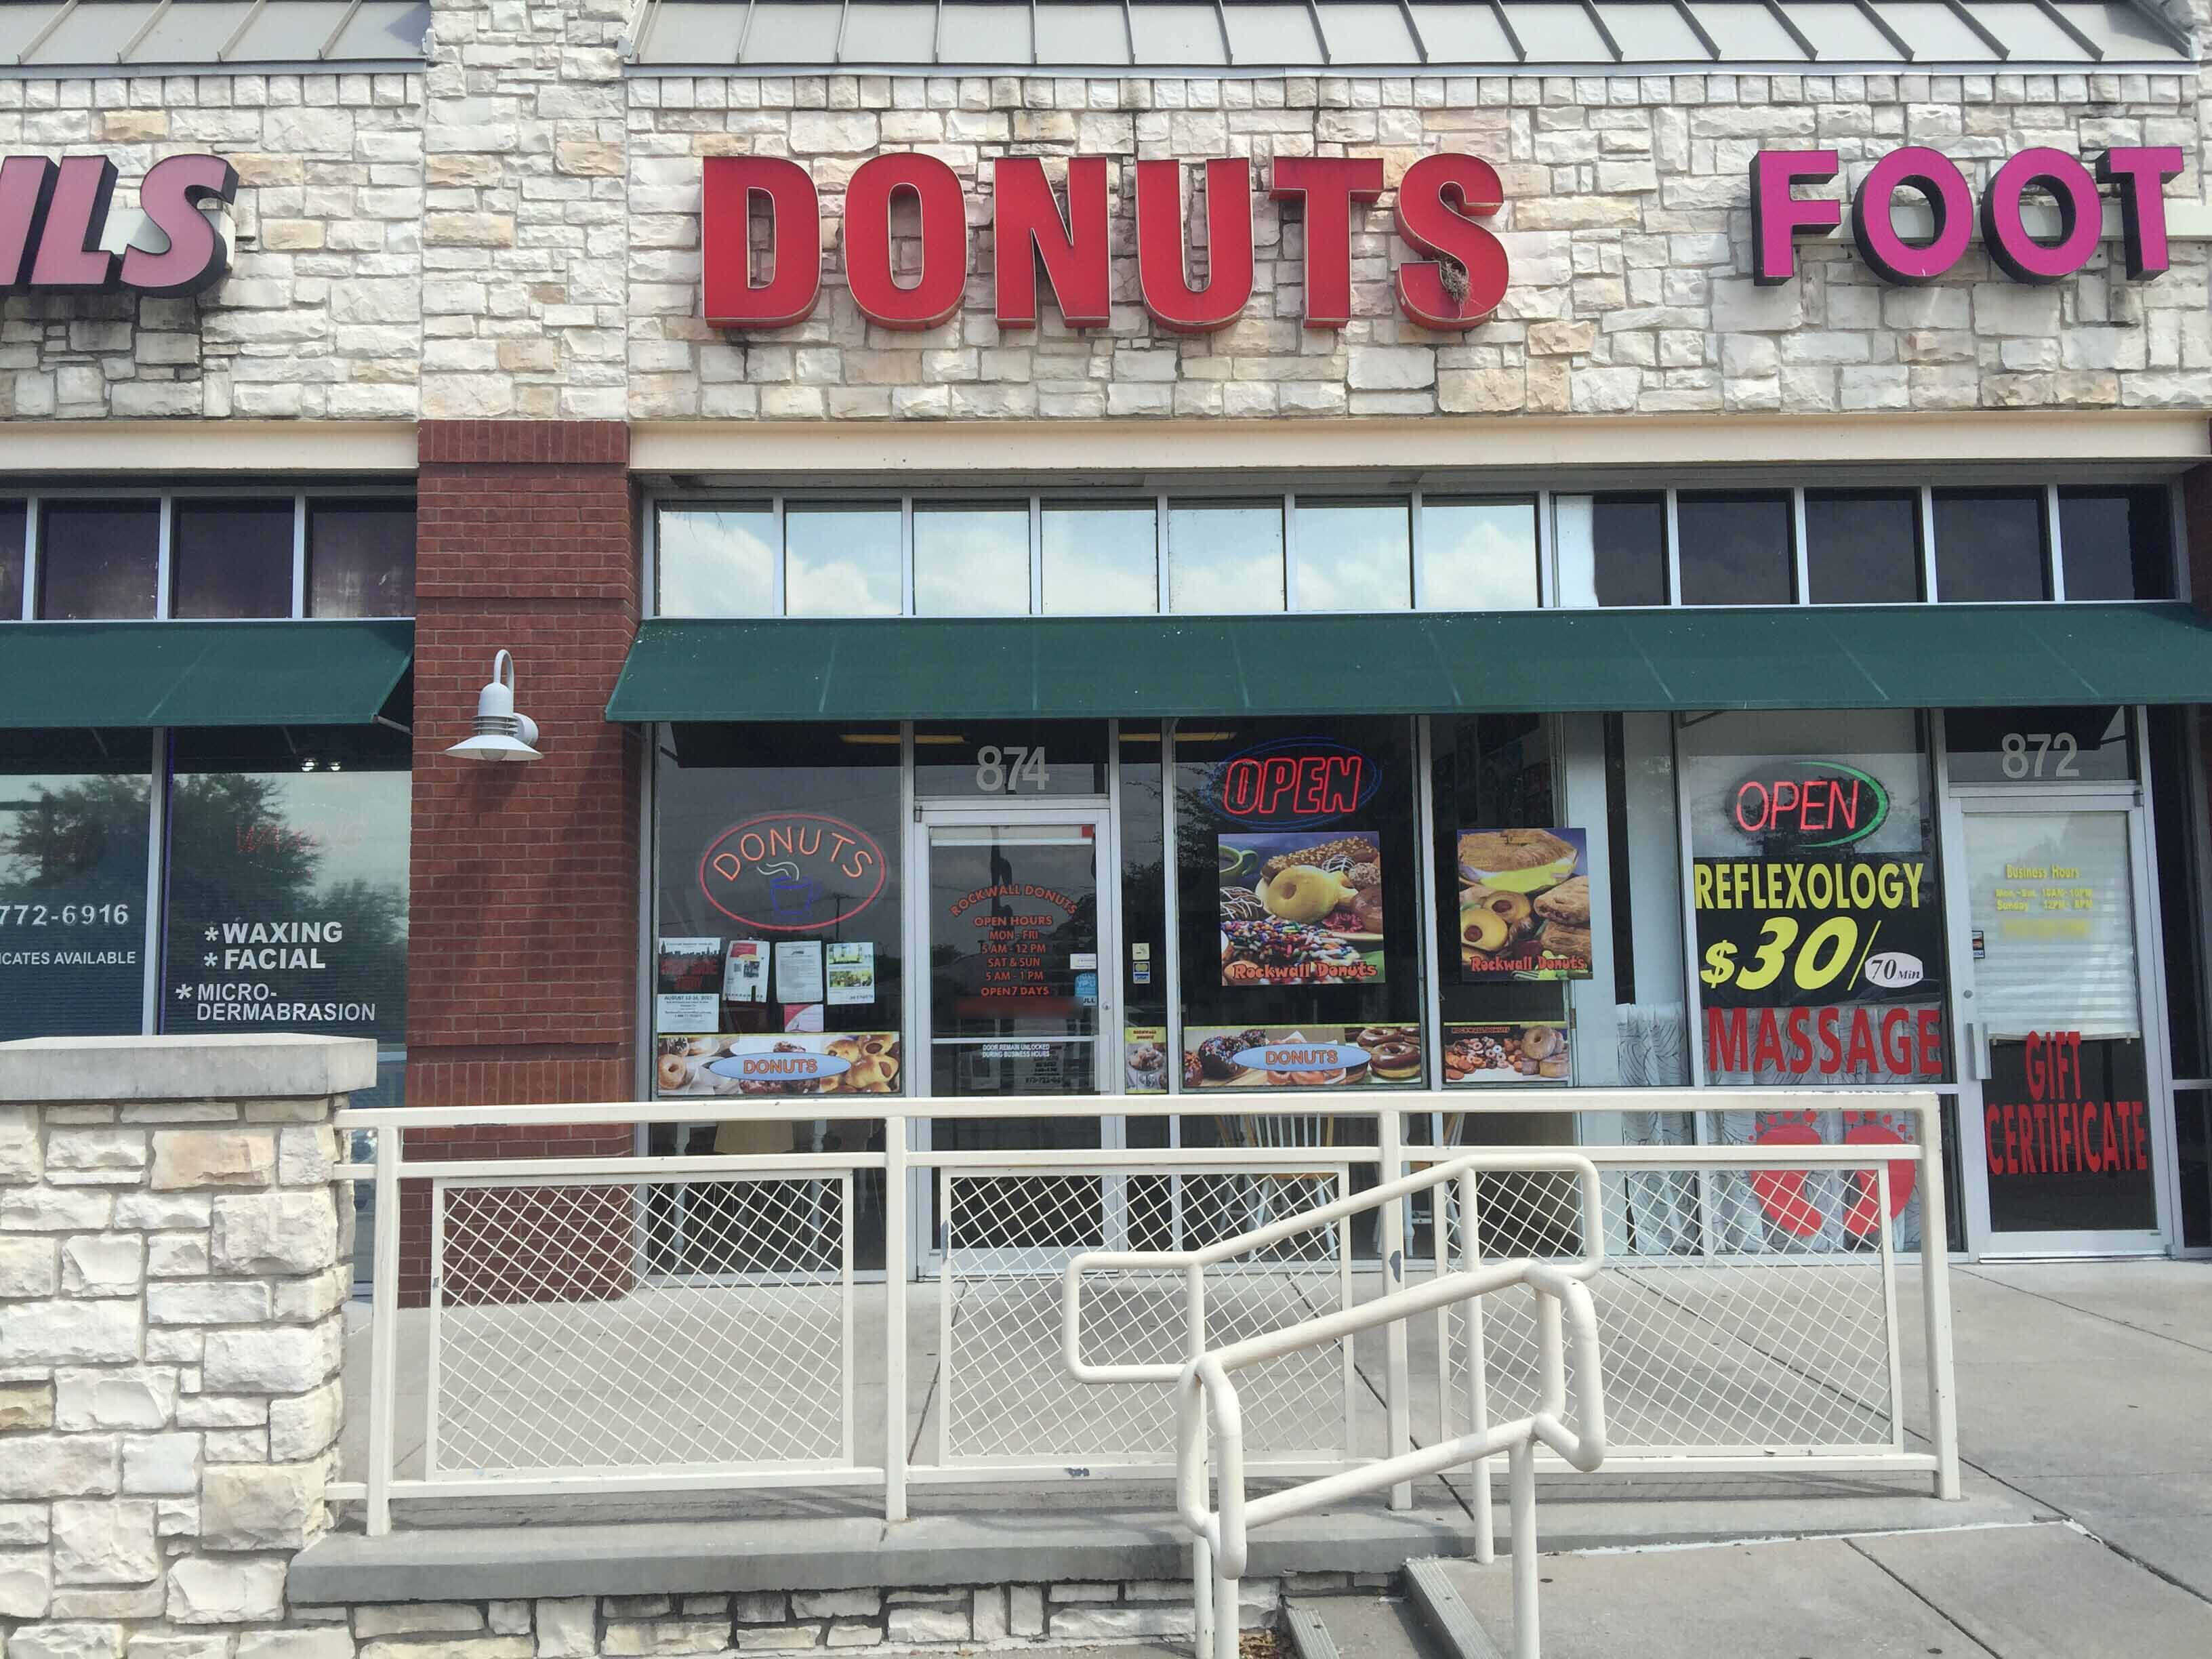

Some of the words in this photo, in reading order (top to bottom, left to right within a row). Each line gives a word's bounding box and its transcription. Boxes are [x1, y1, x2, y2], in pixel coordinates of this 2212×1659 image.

[0, 154, 239, 298] ILS
[1749, 146, 2184, 287] FOOT
[703, 152, 1509, 331] DONUTS
[2001, 732, 2080, 779] 872
[976, 745, 1049, 792] 874
[1224, 756, 1362, 815] OPEN
[1736, 780, 1859, 832] OPEN
[713, 826, 873, 882] DONUTS
[2006, 863, 2047, 878] Business
[2051, 863, 2080, 878] Hours
[1694, 863, 1925, 911] REFLEXOLOGY
[949, 884, 1020, 916] ROCKWALL
[1025, 884, 1078, 915] DONUTS
[0, 904, 129, 926] 772-6916
[975, 917, 1006, 926] OPEN
[1010, 916, 1052, 925] HOURS
[222, 922, 342, 943] WAXING
[989, 930, 1014, 940] MON
[1023, 930, 1039, 939] FRI
[54, 951, 136, 964] AVAILABLE
[224, 948, 325, 970] FACIAL
[982, 944, 987, 954] 5
[989, 944, 1008, 954] AM
[1017, 944, 1027, 953] 12
[1030, 943, 1046, 953] PM
[987, 958, 1006, 968] SAT
[1009, 958, 1017, 967] &
[1019, 958, 1041, 966] SUN
[1233, 964, 1311, 979] Rockwall
[1315, 961, 1377, 977] Donuts
[1470, 955, 1532, 971] Rockwall
[1537, 954, 1586, 970] Donuts
[1870, 959, 1898, 980] 70
[1898, 970, 1921, 980] Min
[986, 971, 991, 981] 5
[994, 971, 1011, 981] AM
[1027, 971, 1044, 981] PM
[197, 983, 277, 1001] MICRO-
[981, 987, 1010, 997] OPEN
[1020, 986, 1050, 996] DAYS
[197, 1003, 375, 1021] DERMABRASION
[1708, 1006, 1942, 1075] MASSAGE
[743, 1059, 818, 1073] DONUTS
[1265, 1049, 1338, 1065] DONUTS
[2025, 1031, 2082, 1102] GIFT
[1986, 1101, 2149, 1176] CERTIFICATE
